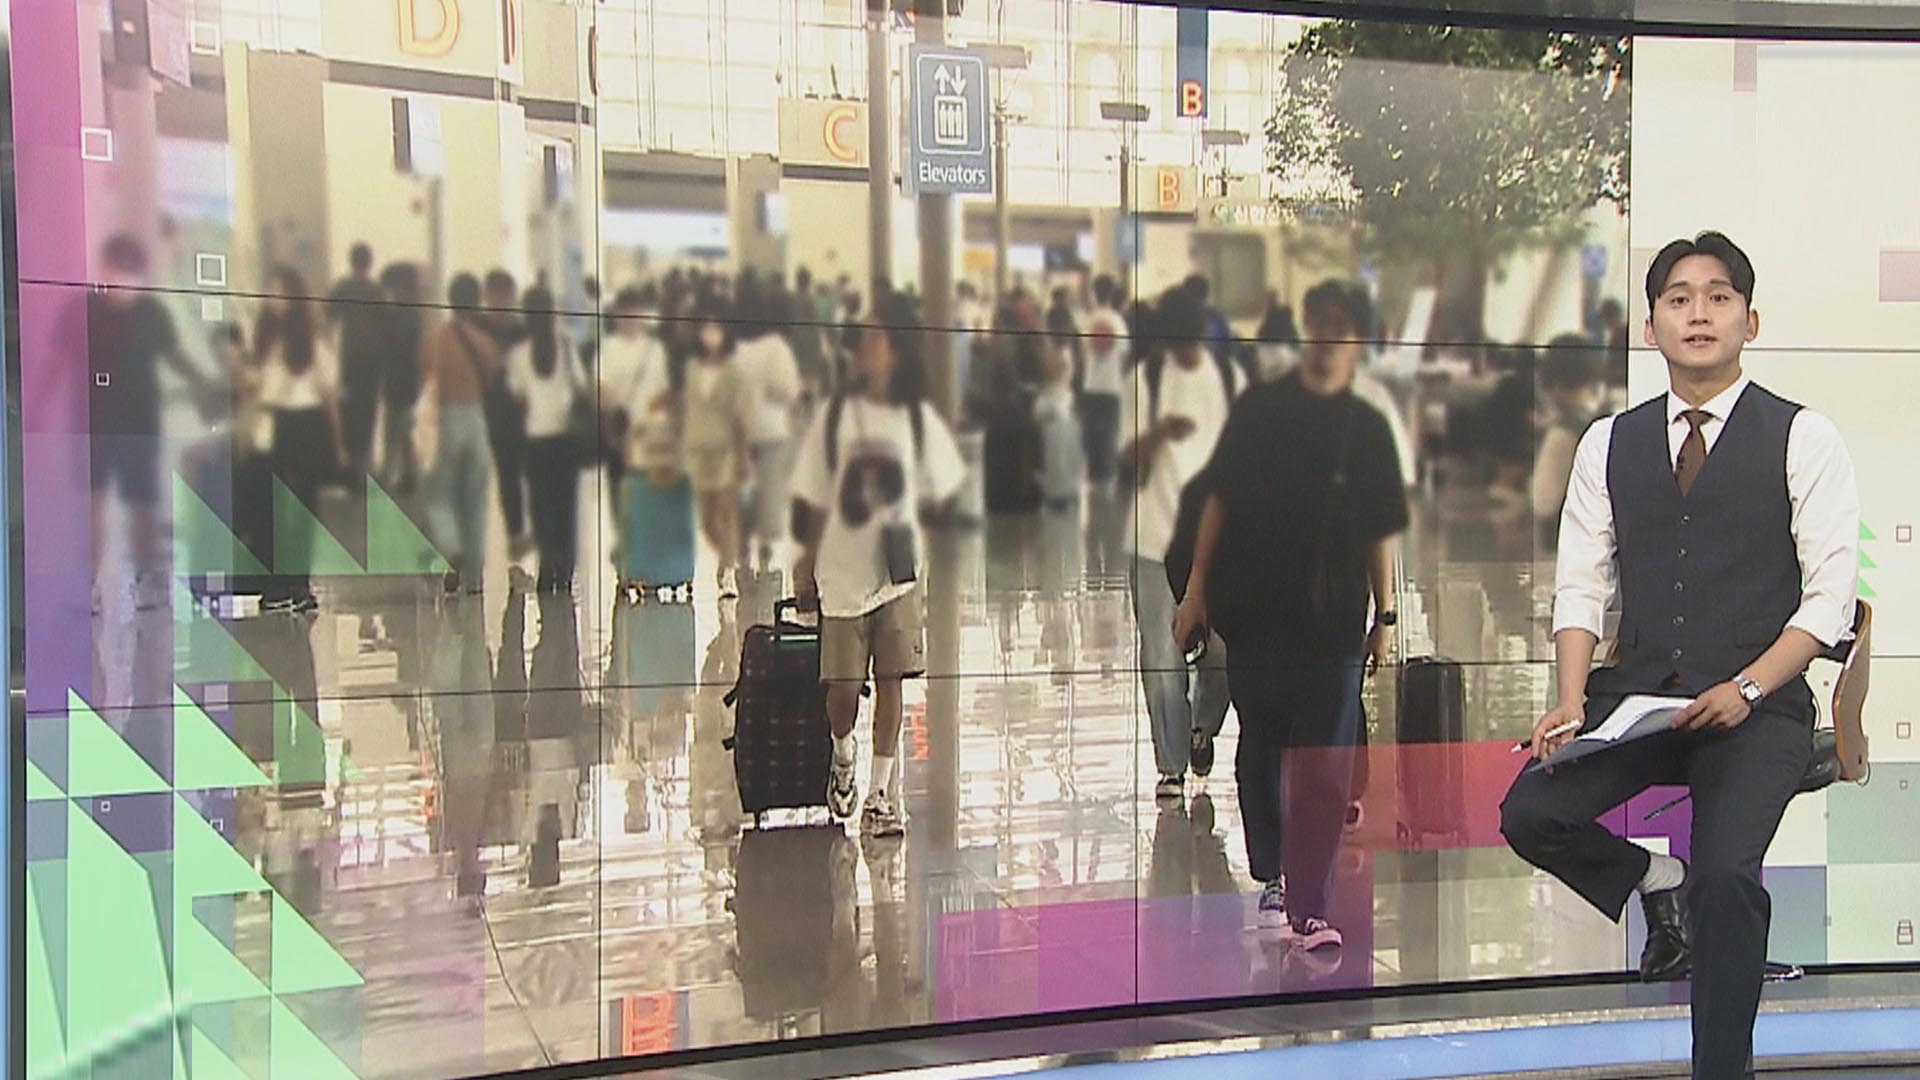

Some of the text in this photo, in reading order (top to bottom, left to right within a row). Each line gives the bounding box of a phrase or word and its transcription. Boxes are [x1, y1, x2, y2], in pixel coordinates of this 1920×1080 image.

[1181, 80, 1202, 117] B
[824, 105, 858, 160] C
[919, 160, 986, 185] Elevators
[1159, 169, 1180, 207] B
